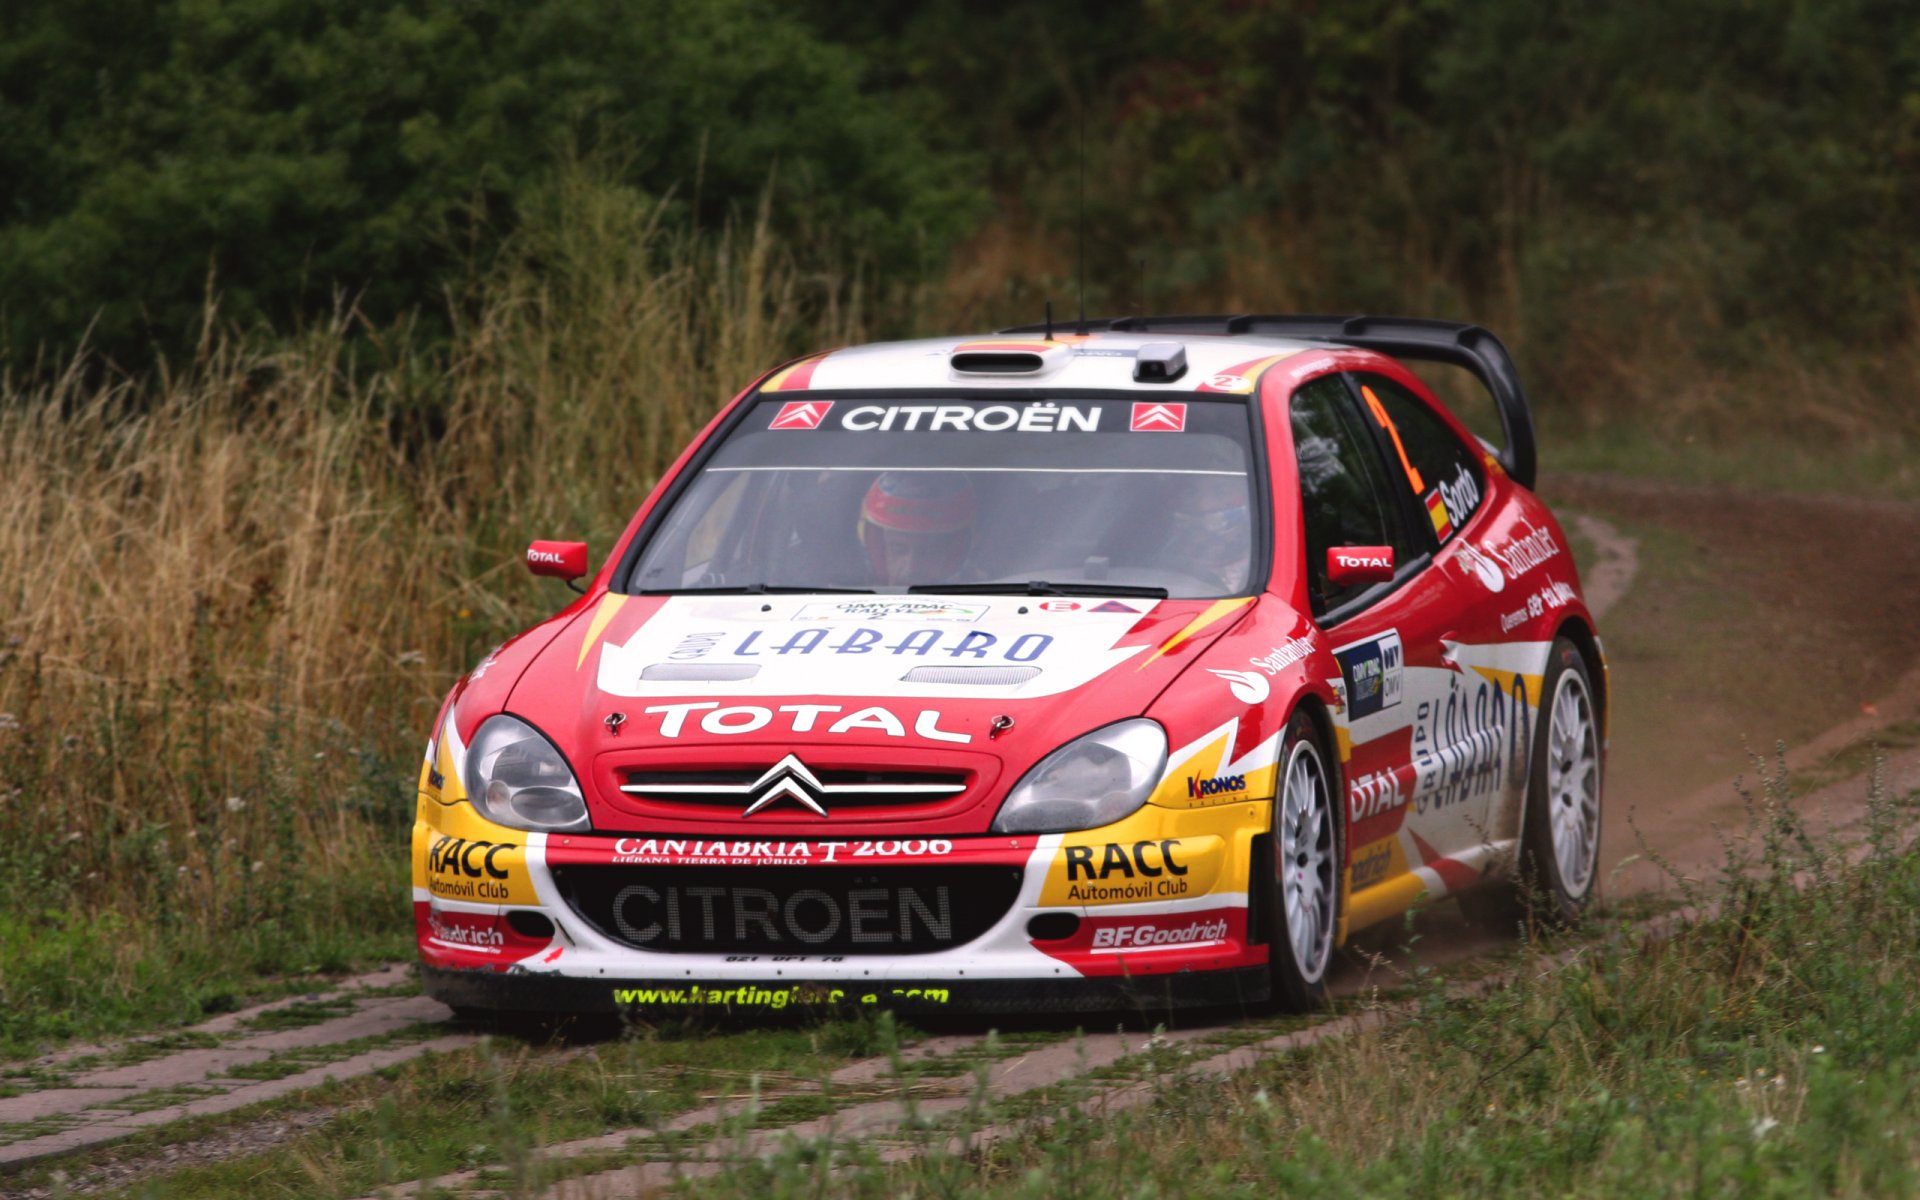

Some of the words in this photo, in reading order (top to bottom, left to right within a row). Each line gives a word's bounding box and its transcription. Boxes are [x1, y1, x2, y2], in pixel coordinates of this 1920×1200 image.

[841, 402, 1103, 432] CITROËN
[1438, 462, 1480, 528] Sordo
[527, 548, 565, 564] TOTAL
[1336, 555, 1392, 568] TOTAL
[1484, 515, 1561, 580] Santander
[1249, 635, 1316, 676] Santander
[645, 701, 972, 743] TOTAL
[1187, 770, 1247, 799] KRONOS
[1350, 767, 1406, 823] OTAL
[429, 836, 518, 879] RACC
[614, 837, 812, 857] CANTABRIA
[853, 839, 953, 857] 2006
[678, 856, 727, 865] TIERRA
[732, 857, 752, 865] DE
[1065, 839, 1189, 881] RACC
[478, 881, 509, 899] Club
[1068, 881, 1152, 900] Automóvil
[1157, 878, 1188, 896] Club
[613, 876, 951, 943] CITROËN
